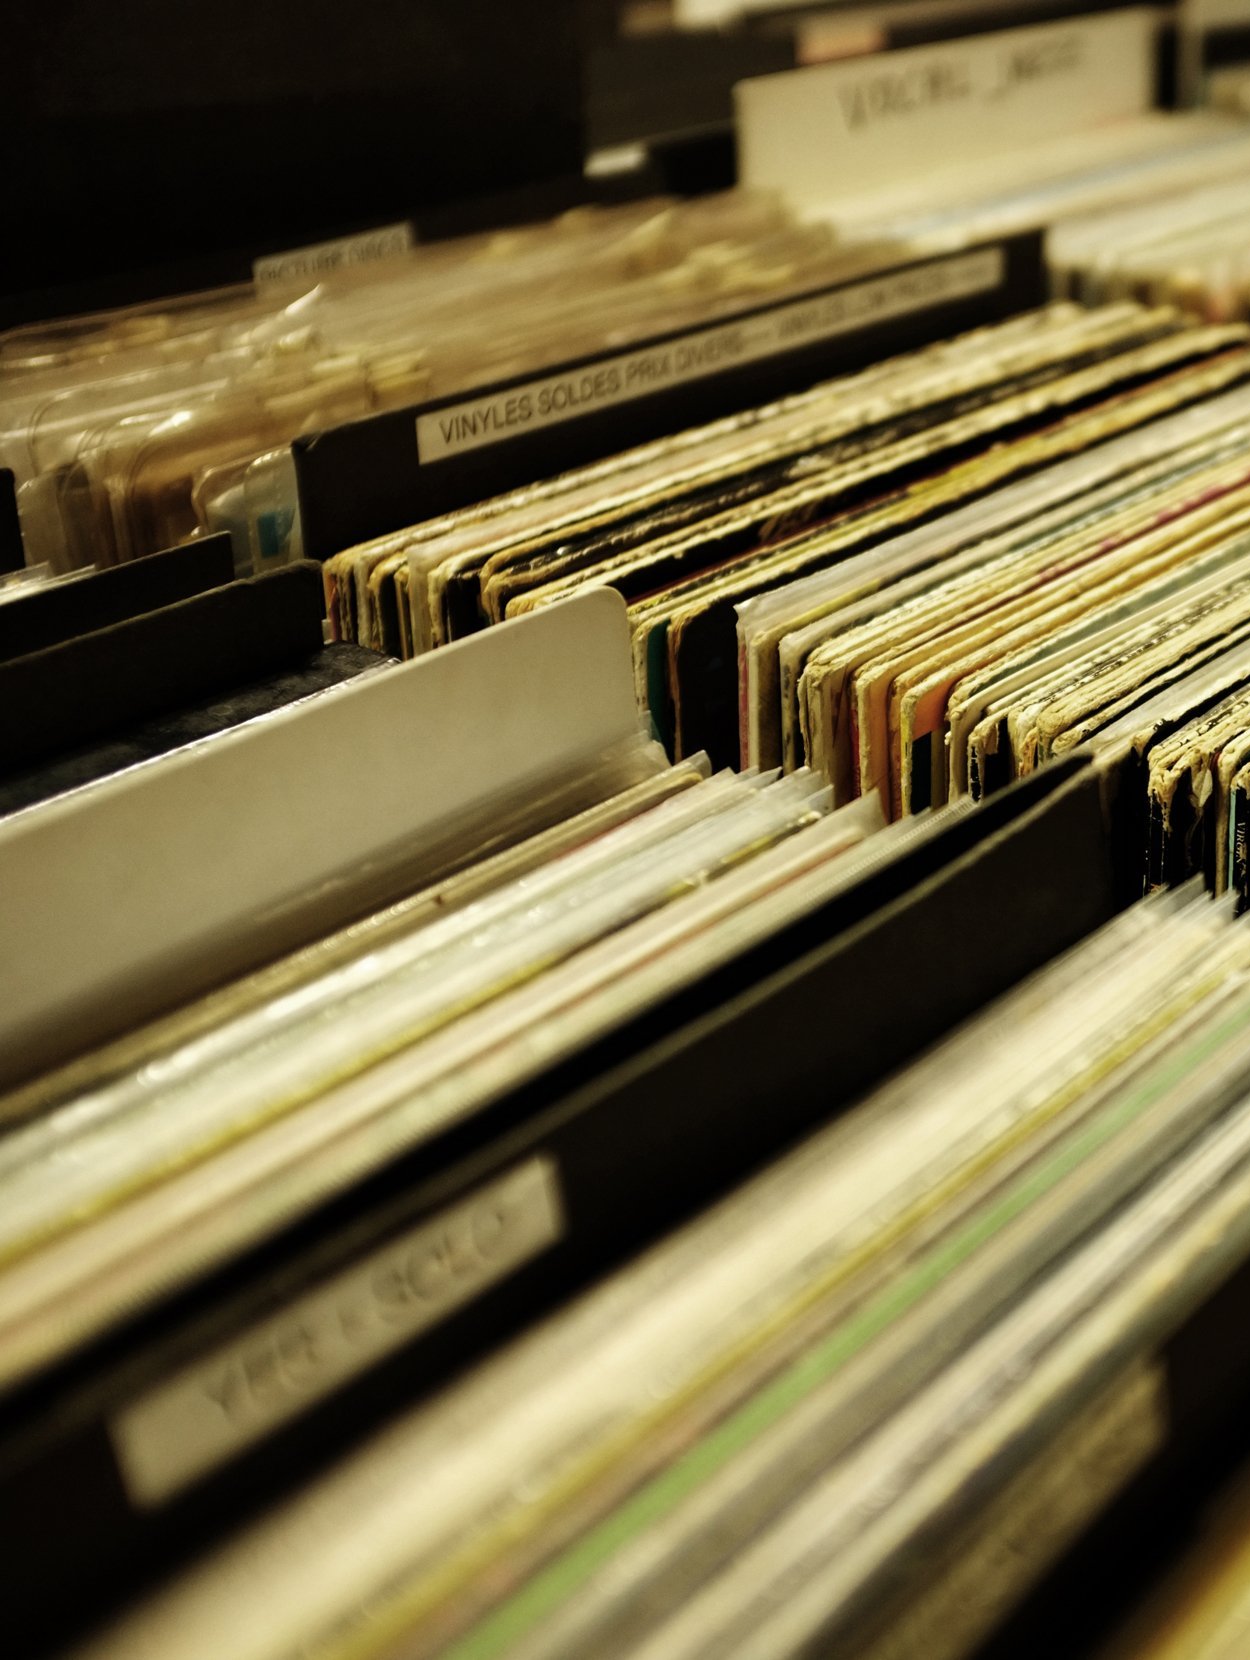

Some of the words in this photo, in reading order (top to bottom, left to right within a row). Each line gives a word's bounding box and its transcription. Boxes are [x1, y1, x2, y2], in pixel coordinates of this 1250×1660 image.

[439, 394, 533, 444] VINYLES
[537, 366, 621, 415] SOLDES
[626, 352, 671, 385] PRIX
